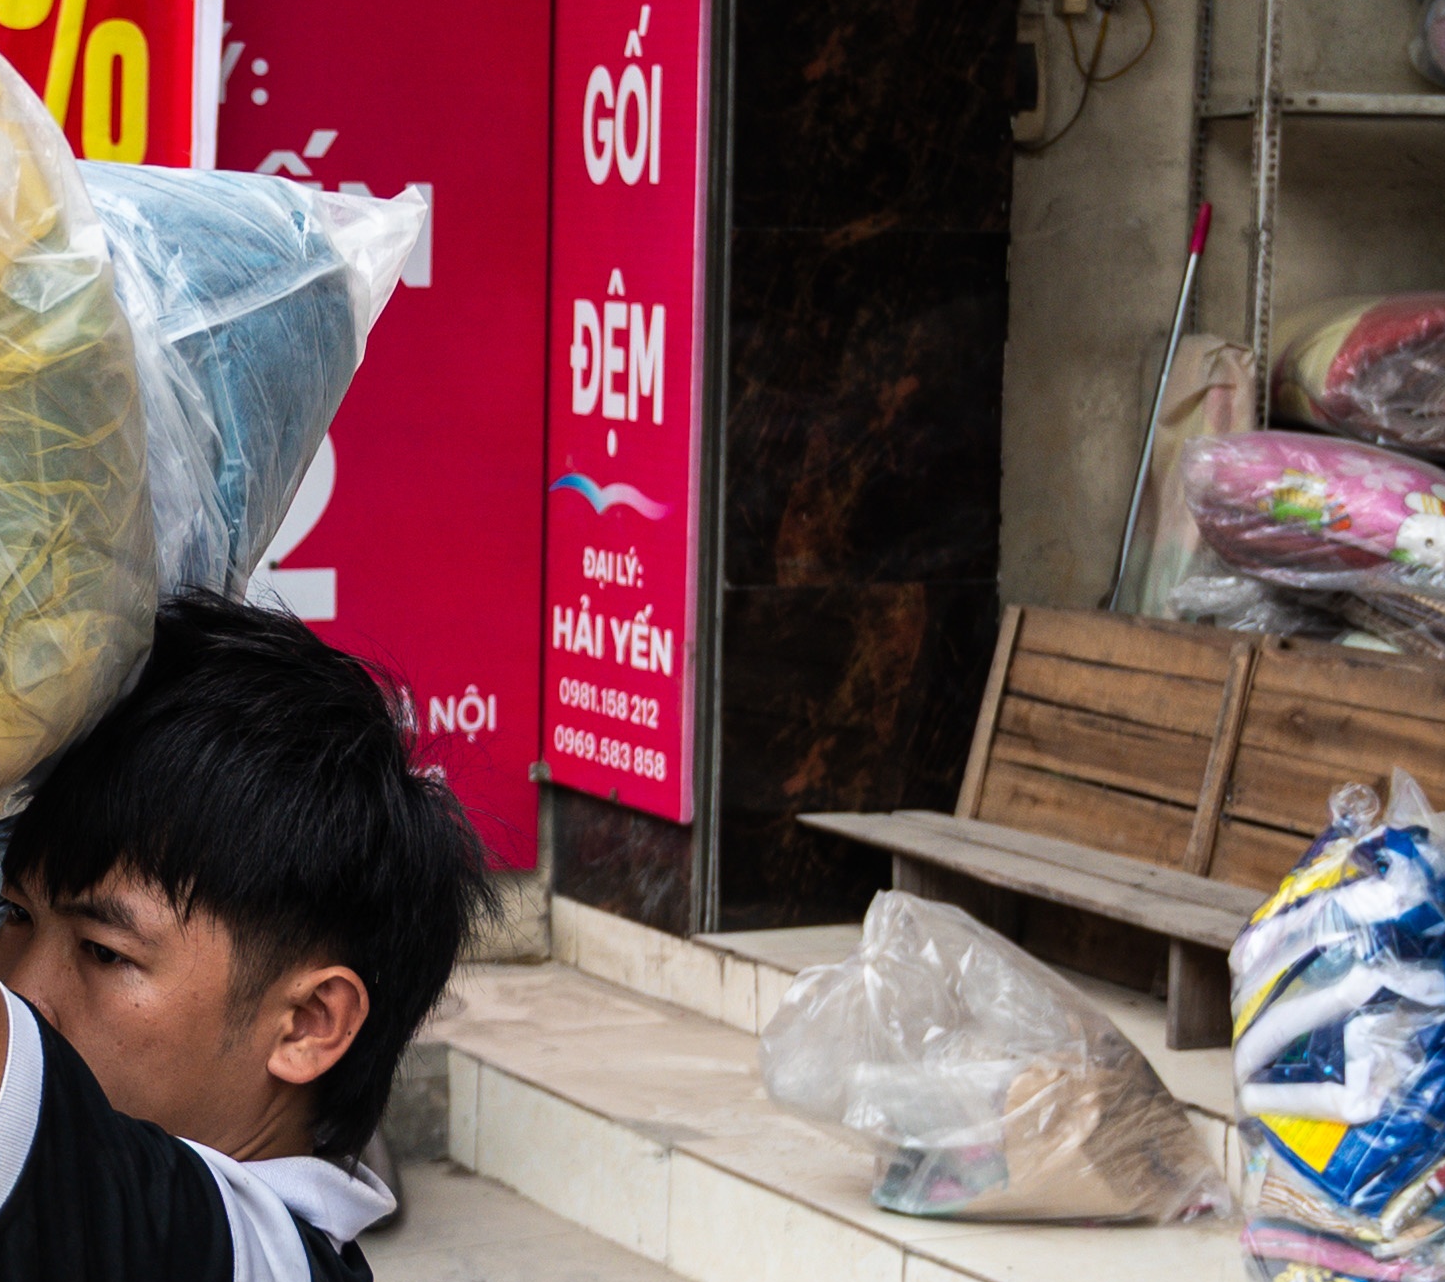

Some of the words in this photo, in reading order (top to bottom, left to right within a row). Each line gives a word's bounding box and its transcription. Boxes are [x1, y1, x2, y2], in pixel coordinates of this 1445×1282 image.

[583, 5, 661, 186] GỐI
[571, 268, 664, 457] ĐỆM
[583, 546, 613, 589] ĐẠI
[616, 546, 644, 588] LÝ:
[553, 594, 605, 659] HẢI
[610, 603, 673, 676] YẾN
[429, 683, 497, 743] NỘI
[559, 676, 629, 721] 0981.158
[630, 693, 659, 729] 212
[553, 723, 630, 771] 0969.583
[633, 745, 667, 781] 858
